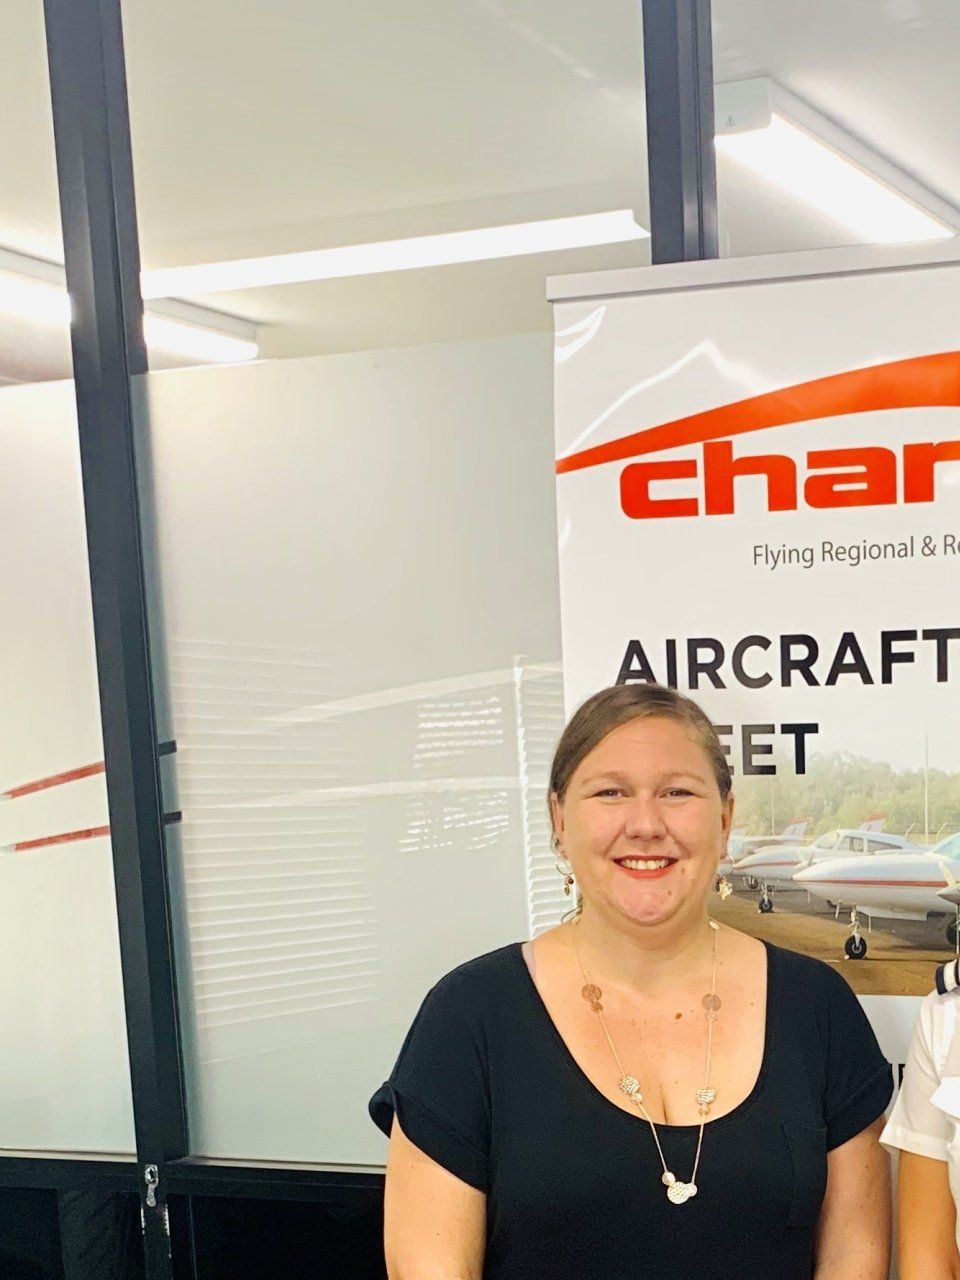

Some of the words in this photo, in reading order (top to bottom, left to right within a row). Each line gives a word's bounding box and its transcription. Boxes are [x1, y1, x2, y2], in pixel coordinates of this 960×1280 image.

[753, 543, 814, 570] Flying
[821, 535, 913, 566] Regional
[921, 535, 936, 556] &
